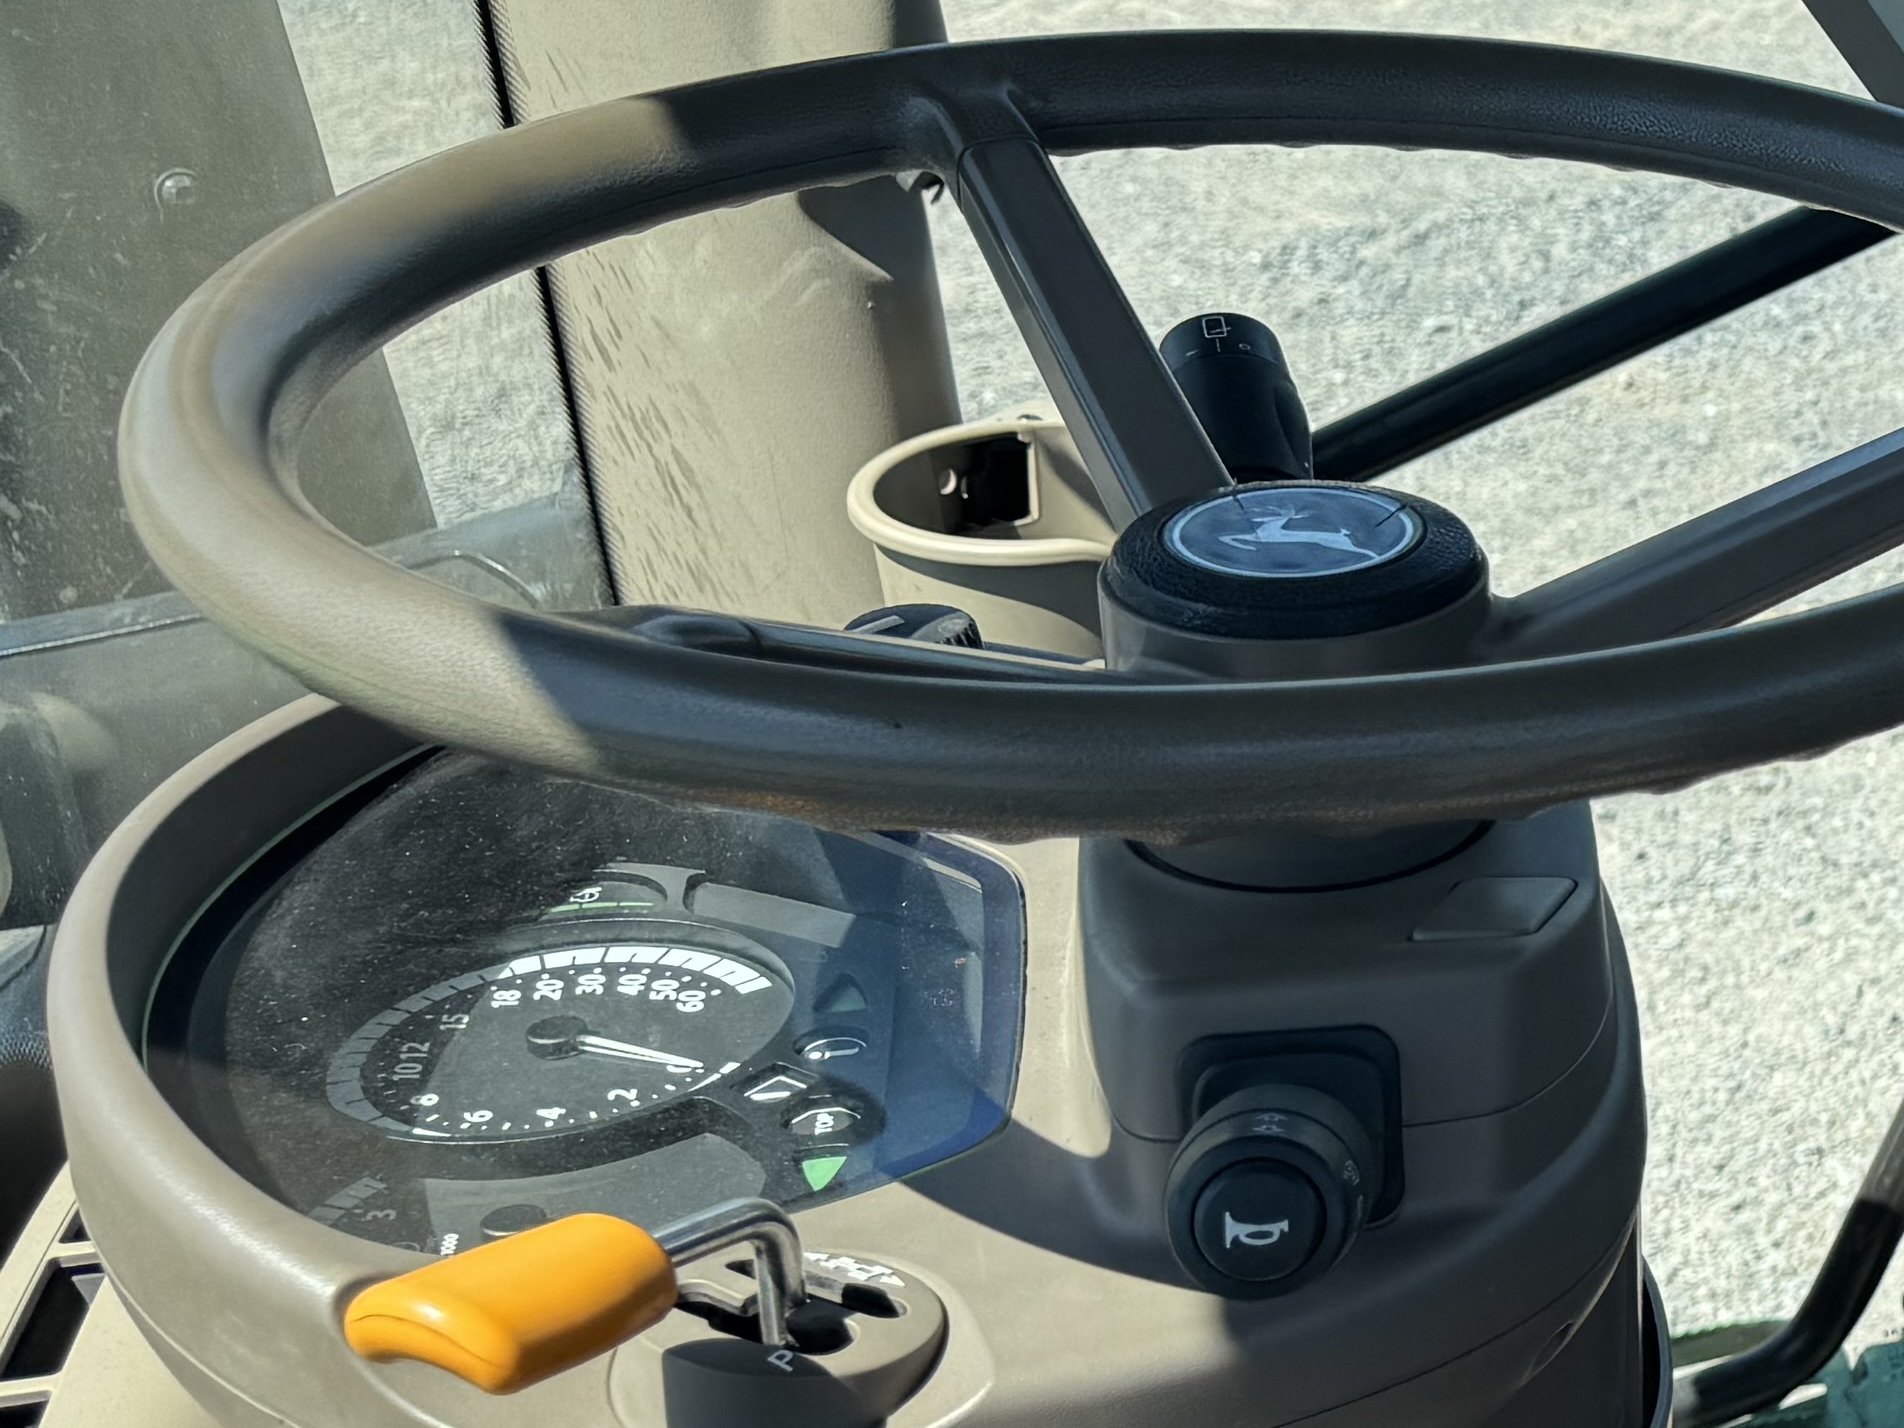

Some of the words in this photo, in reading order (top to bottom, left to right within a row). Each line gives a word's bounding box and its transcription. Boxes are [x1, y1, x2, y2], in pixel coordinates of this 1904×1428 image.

[533, 978, 564, 1000] 20
[575, 972, 605, 995] 30
[617, 972, 648, 996] 40
[649, 979, 679, 1002] 50
[491, 989, 522, 1008] 18
[677, 989, 706, 1012] 60
[439, 1012, 470, 1031] 15
[400, 1041, 430, 1063] 12
[393, 1060, 423, 1081] 10
[410, 1092, 439, 1107] 8
[608, 1088, 637, 1102] 2
[463, 1109, 493, 1124] 6
[537, 1107, 566, 1121] 4
[815, 1113, 834, 1136] TOP
[367, 1208, 397, 1221] 3
[767, 1349, 794, 1372] P
